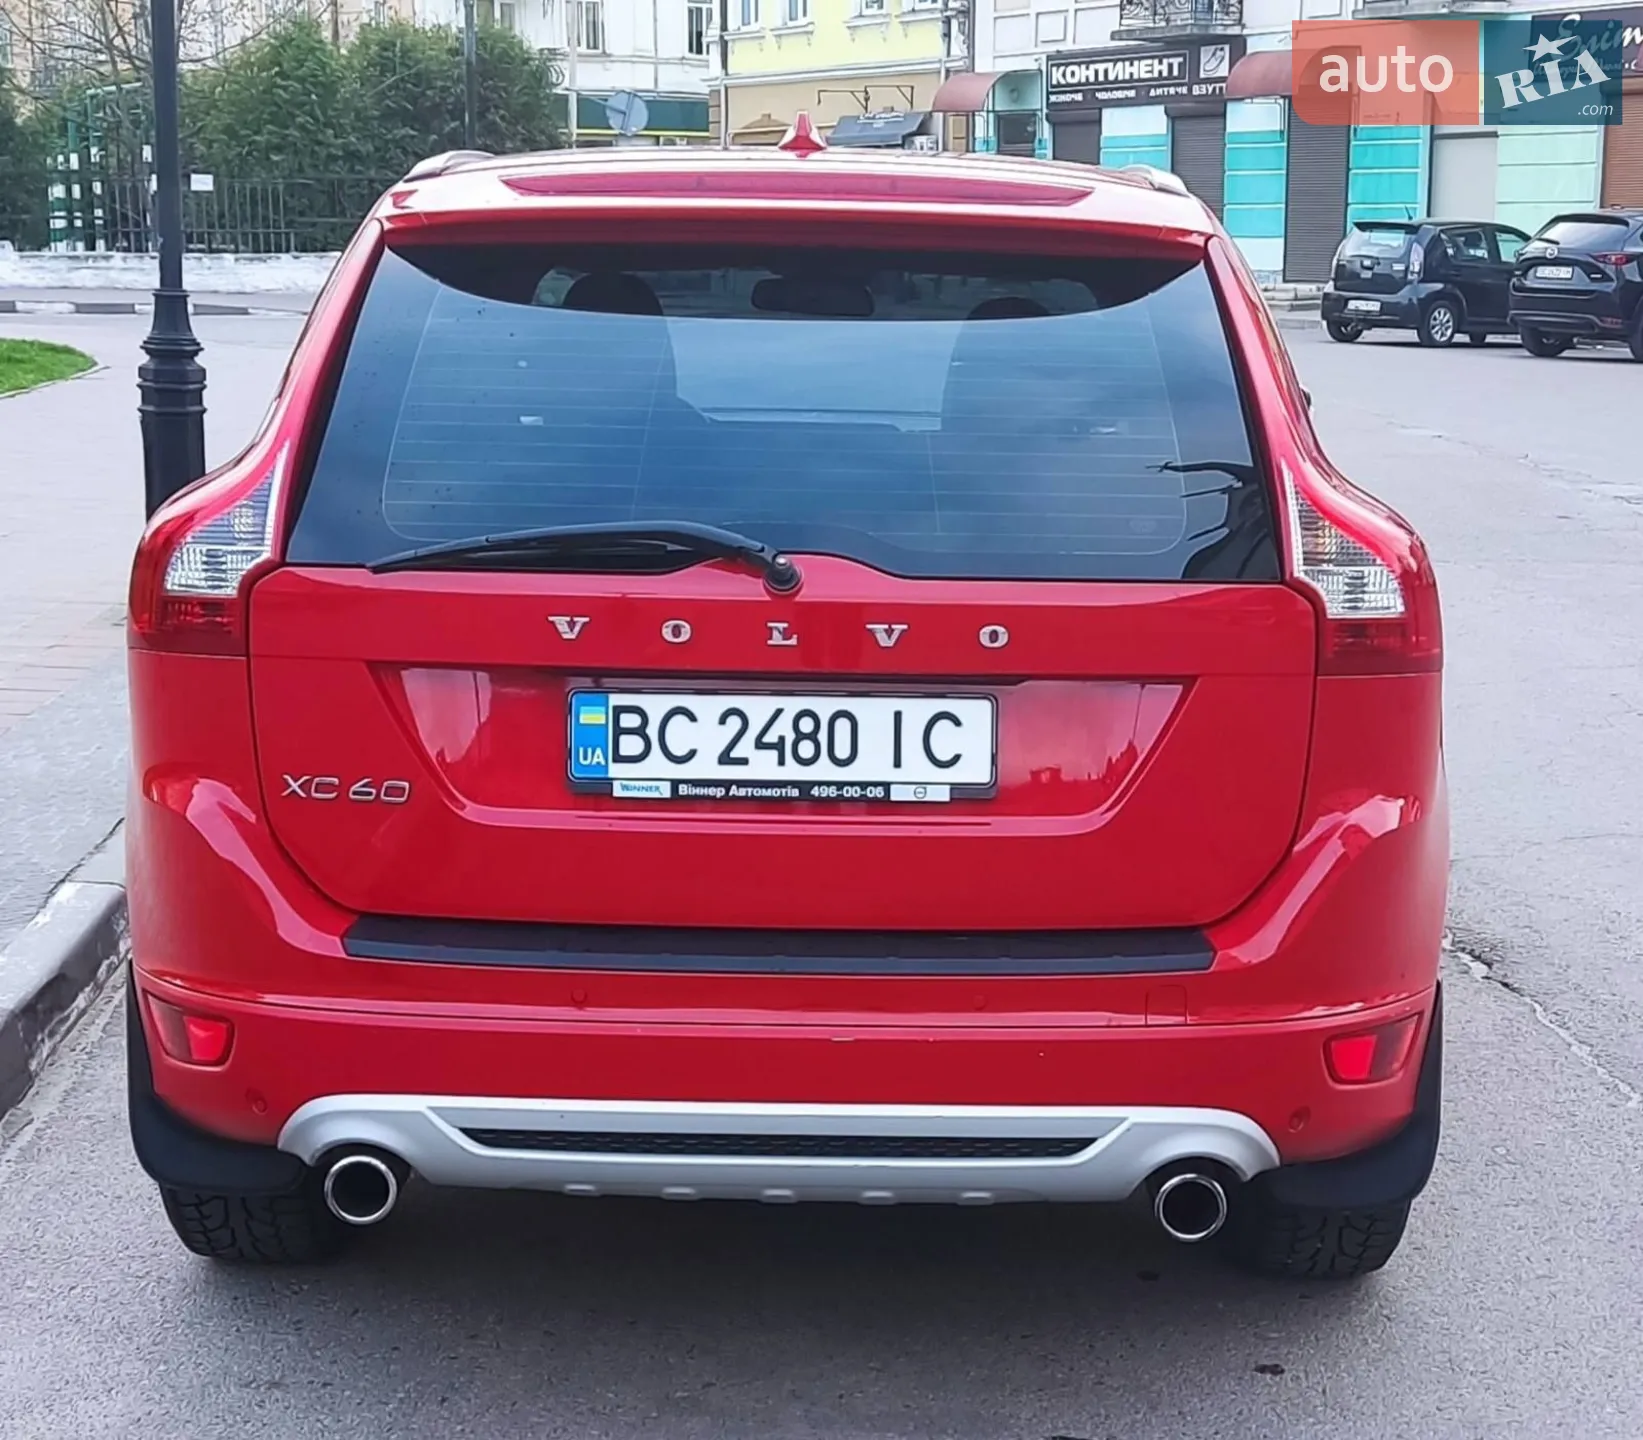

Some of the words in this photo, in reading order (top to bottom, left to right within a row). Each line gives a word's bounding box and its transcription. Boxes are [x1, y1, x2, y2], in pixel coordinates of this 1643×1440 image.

[1051, 57, 1184, 85] КОНТИНЕНТ
[1149, 86, 1188, 97] ДИТЯЧЕ
[1192, 83, 1227, 96] ВЗУТТ
[547, 615, 1010, 648] VOLVO
[612, 705, 699, 765] BC
[717, 706, 859, 768] 2480
[893, 710, 963, 769] IC
[579, 747, 607, 766] UA
[620, 782, 664, 796] WINNER
[678, 784, 726, 798] Віннер
[728, 784, 800, 798] Автомотів
[810, 785, 885, 798] 496-00-06
